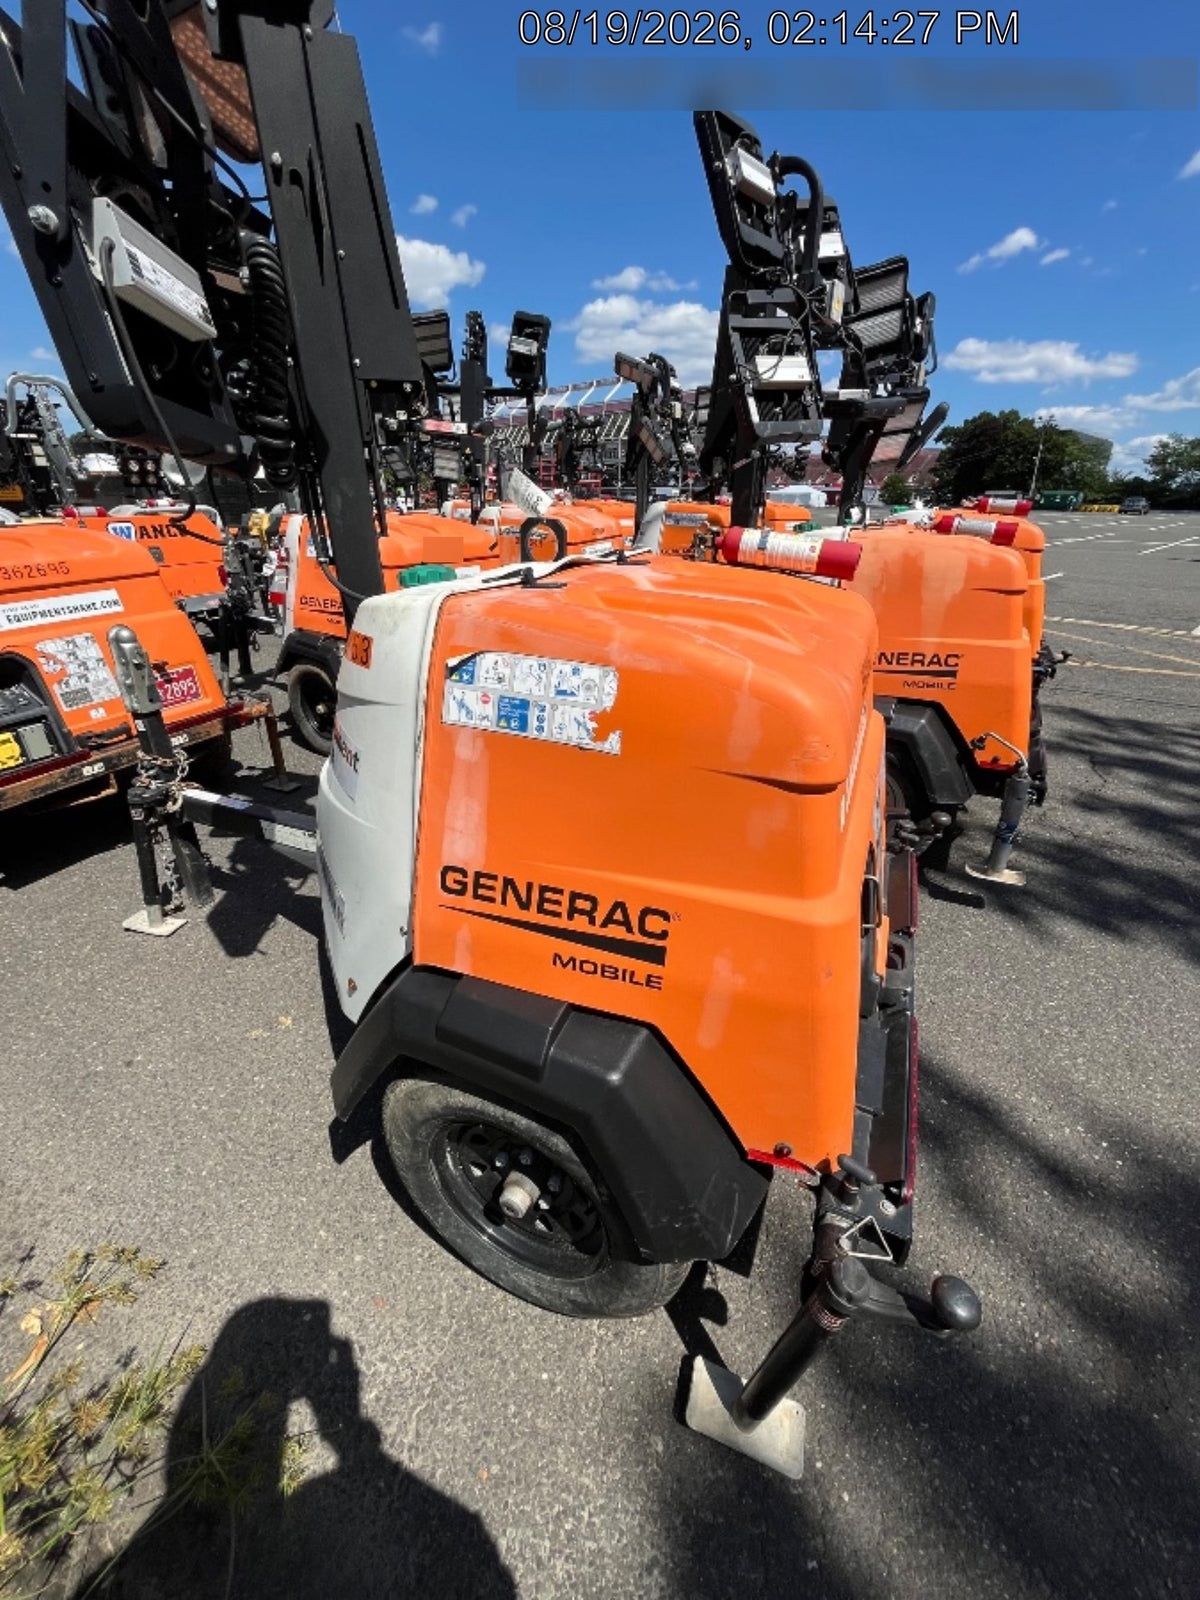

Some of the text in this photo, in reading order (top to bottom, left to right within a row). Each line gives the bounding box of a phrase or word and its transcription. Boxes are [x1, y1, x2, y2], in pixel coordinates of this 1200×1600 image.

[873, 651, 959, 668] NERAC
[440, 865, 671, 940] GENERAC
[552, 952, 664, 991] MOBILE
